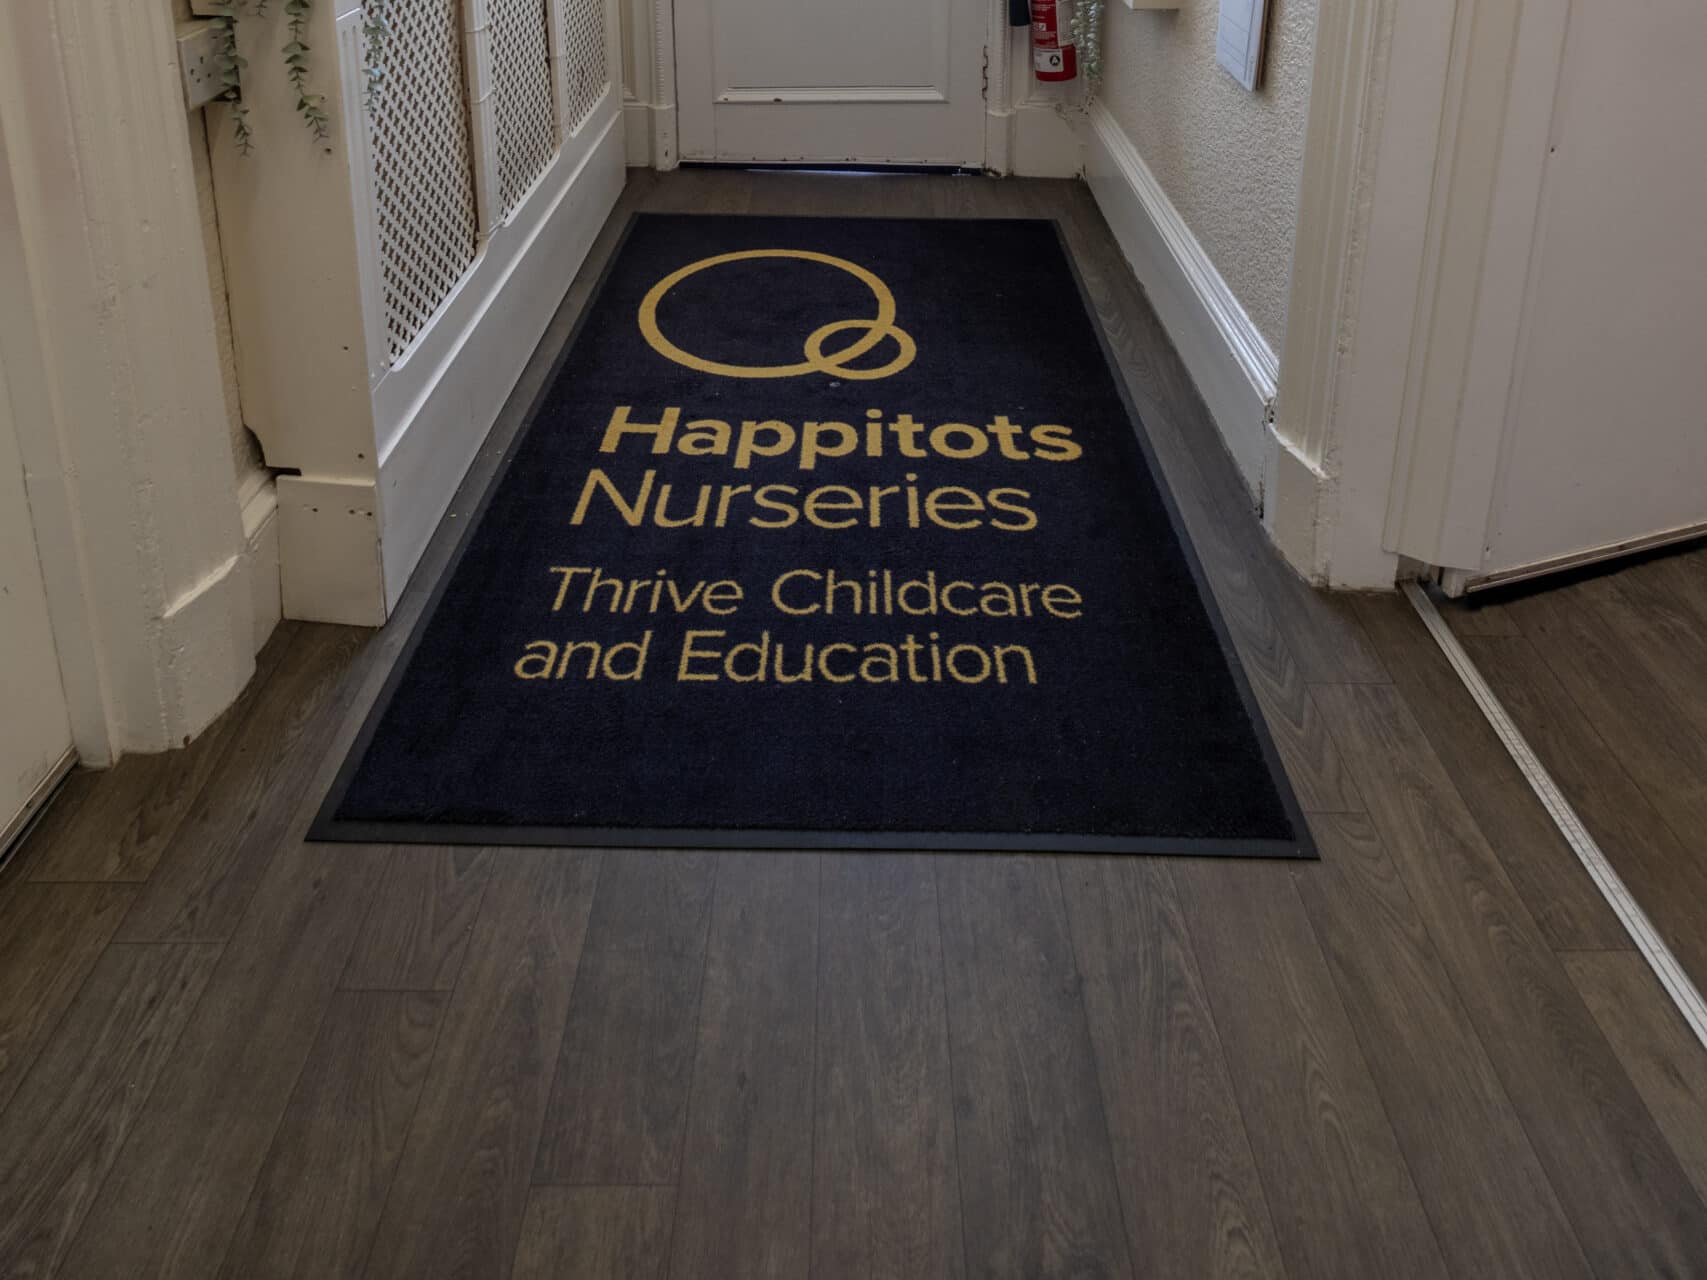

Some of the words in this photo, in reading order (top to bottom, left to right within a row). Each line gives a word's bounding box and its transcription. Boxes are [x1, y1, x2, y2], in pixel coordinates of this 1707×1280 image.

[600, 406, 1082, 469] Happitots
[570, 469, 1038, 531] Nurseries
[550, 567, 743, 615] Thrive
[772, 569, 1082, 618] Childcare
[514, 631, 652, 680] and
[677, 630, 1037, 684] Education
